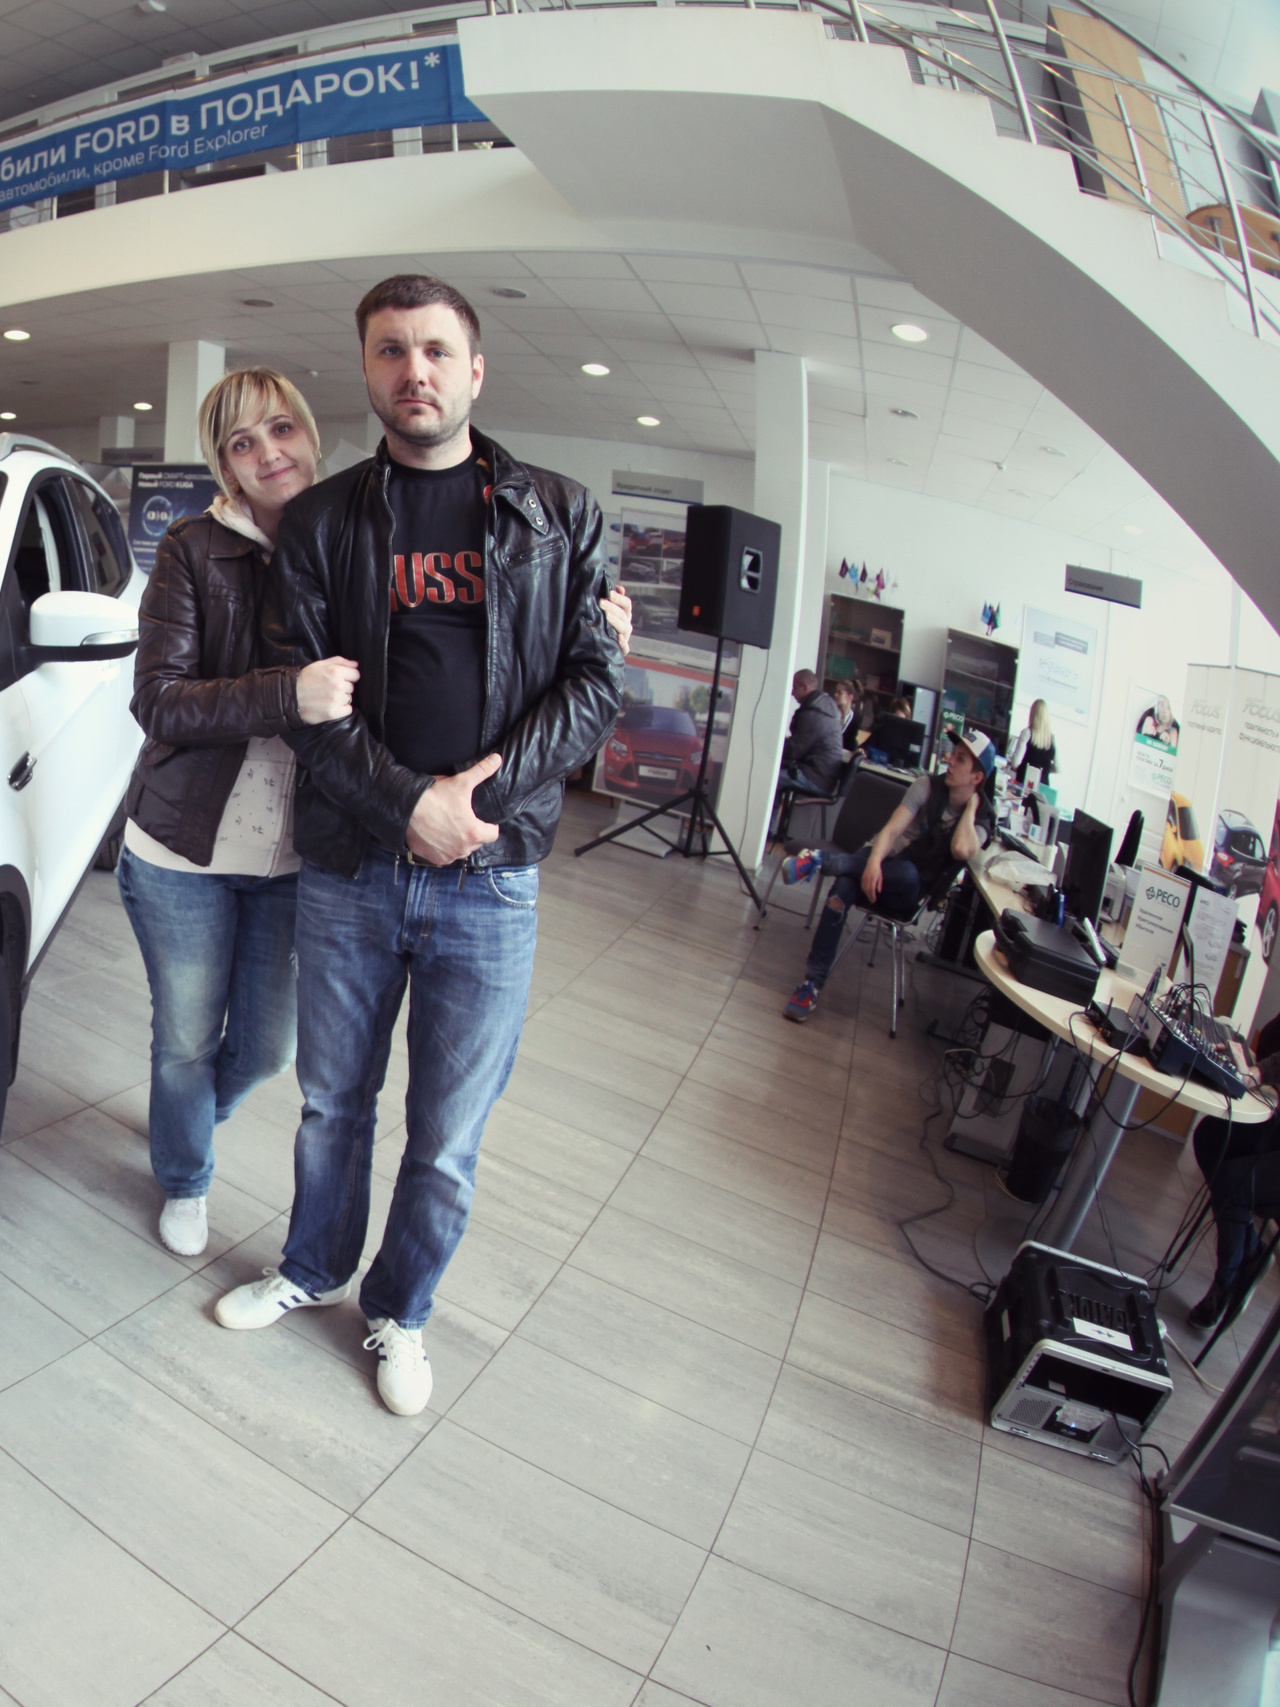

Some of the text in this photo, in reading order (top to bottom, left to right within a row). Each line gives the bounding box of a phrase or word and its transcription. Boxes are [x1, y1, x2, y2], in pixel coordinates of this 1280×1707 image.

[74, 114, 161, 159] FORD
[170, 115, 190, 135] в
[93, 152, 145, 177] кроме
[148, 141, 189, 161] Ford
[194, 124, 269, 156] Explorer
[390, 551, 484, 612] USS
